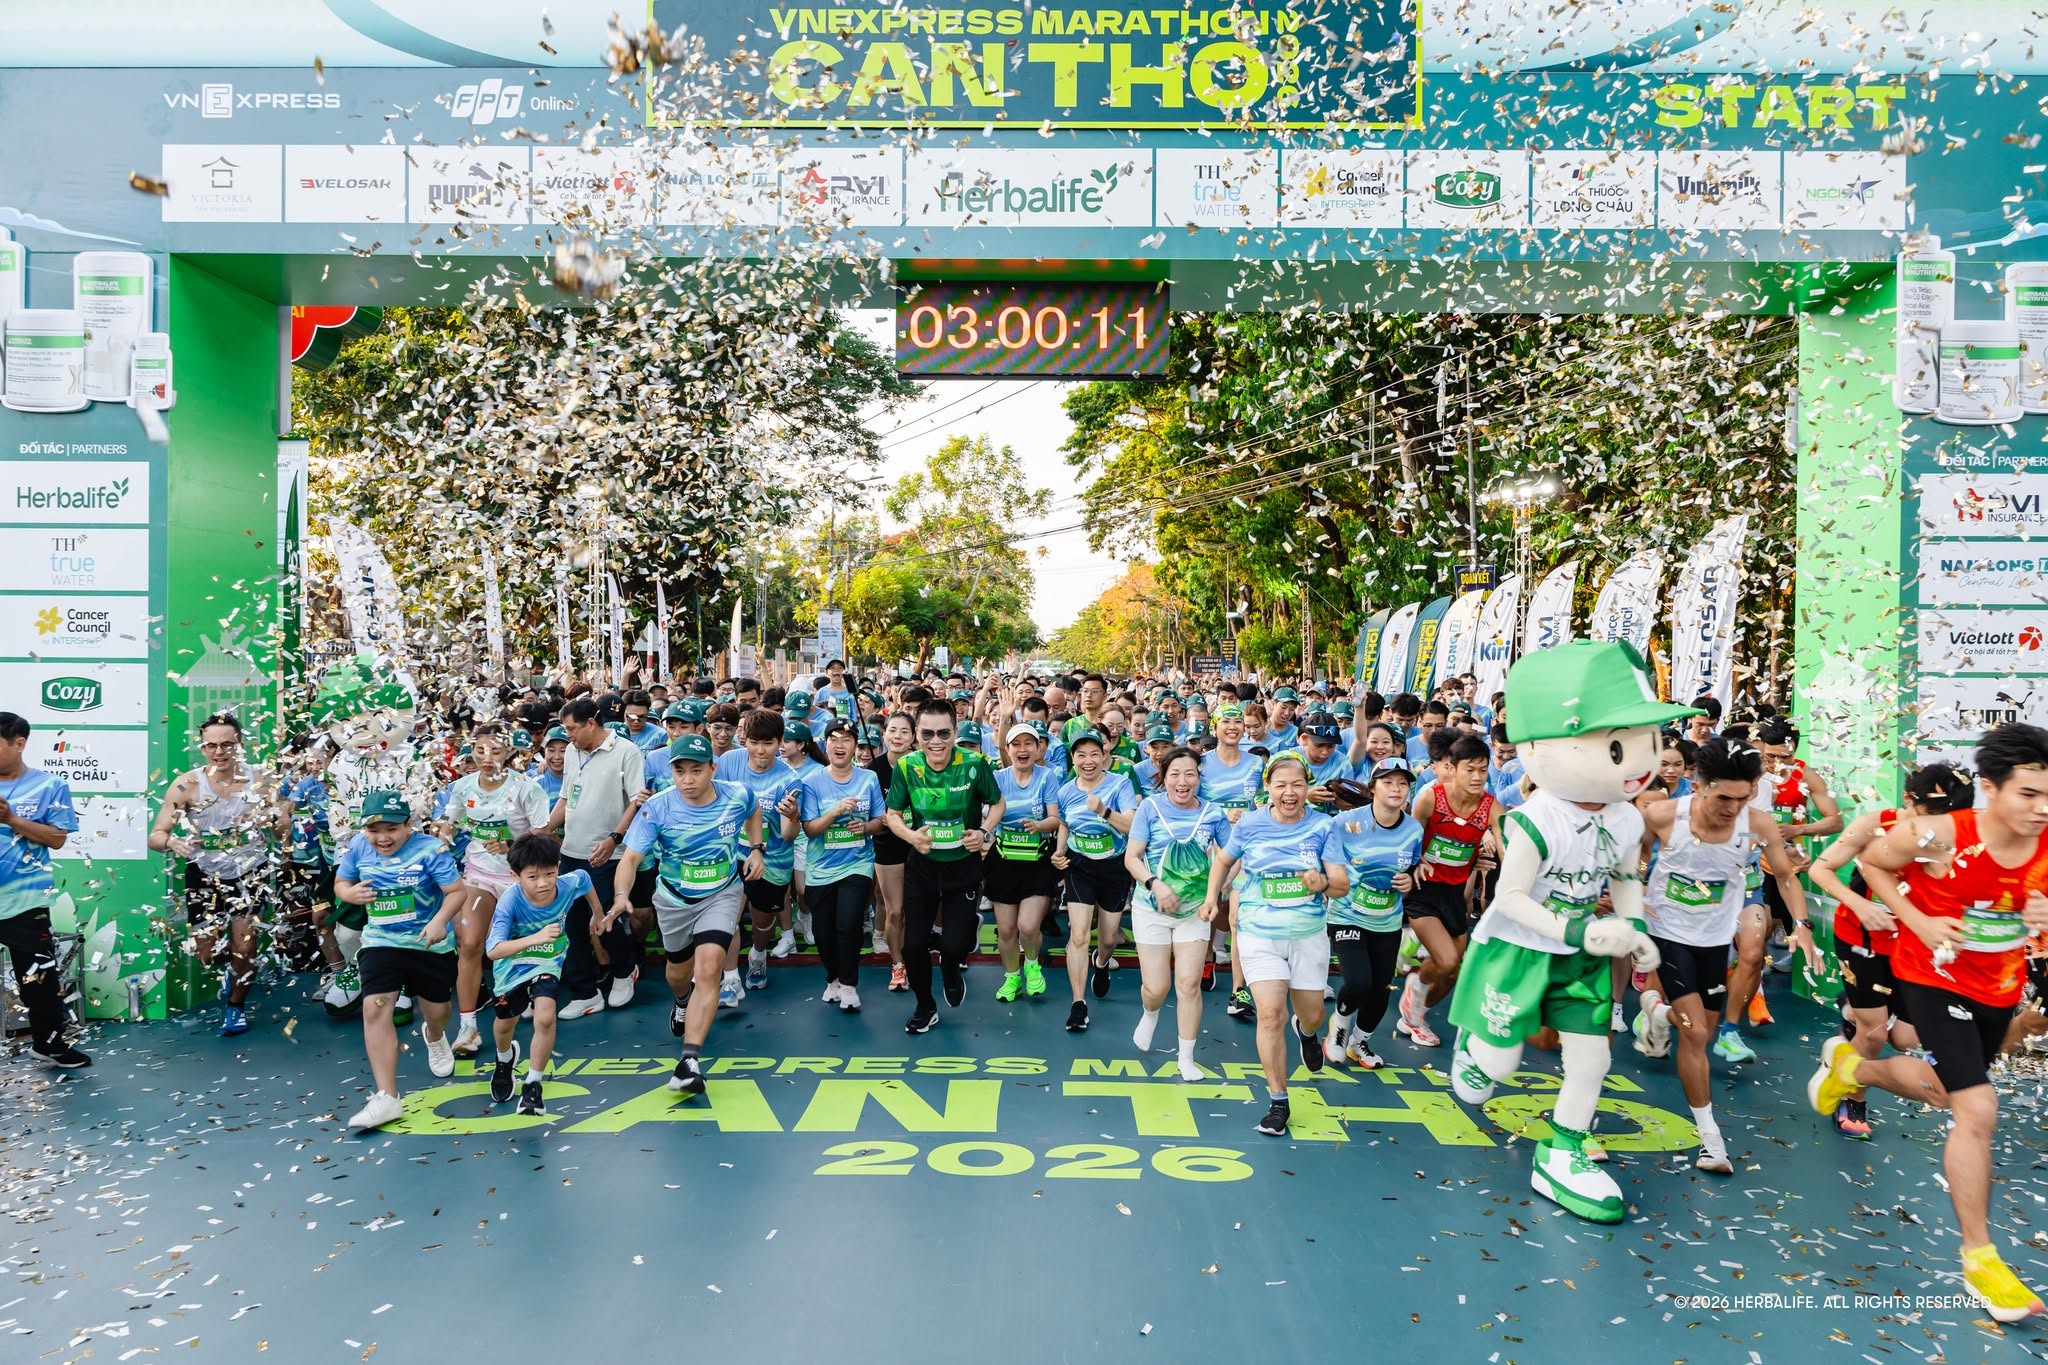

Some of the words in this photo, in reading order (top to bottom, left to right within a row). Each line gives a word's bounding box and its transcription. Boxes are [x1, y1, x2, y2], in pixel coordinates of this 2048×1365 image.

[770, 8, 1024, 36] VNEXPRESS
[1030, 9, 1268, 36] MARATHON
[769, 40, 1006, 108] CAN
[1027, 41, 1268, 109] THO
[163, 84, 341, 118] VNEXPRESS
[1654, 84, 1906, 129] START
[1194, 164, 1221, 179] TH
[428, 184, 492, 206] PUMA
[940, 177, 1104, 214] Herbalife
[1193, 181, 1241, 202] true
[1440, 176, 1495, 201] Cozy
[909, 305, 1146, 350] 03:00:11
[19, 441, 44, 454] ĐỐI
[43, 442, 65, 454] TÁC
[71, 443, 128, 455] PARTNERS
[16, 486, 120, 509] Herbalife
[52, 537, 76, 551] TH
[51, 553, 95, 573] true
[51, 575, 95, 586] WATER
[67, 608, 109, 620] Cancer
[67, 620, 111, 633] Council
[1696, 563, 1722, 697] VELOSAR
[1950, 631, 2015, 645] Vietlott
[1479, 639, 1511, 662] Kiri
[46, 682, 97, 709] Cozy
[44, 756, 64, 767] NHÀ
[66, 755, 99, 767] THUỐC
[71, 768, 108, 781] CHÂU
[684, 868, 691, 877] A
[1267, 883, 1274, 894] D
[1358, 891, 1365, 901] A
[1335, 929, 1361, 939] RUN
[376, 1079, 1003, 1134] CAN
[1062, 1081, 1702, 1152] THO
[813, 1140, 1254, 1183] 2026
